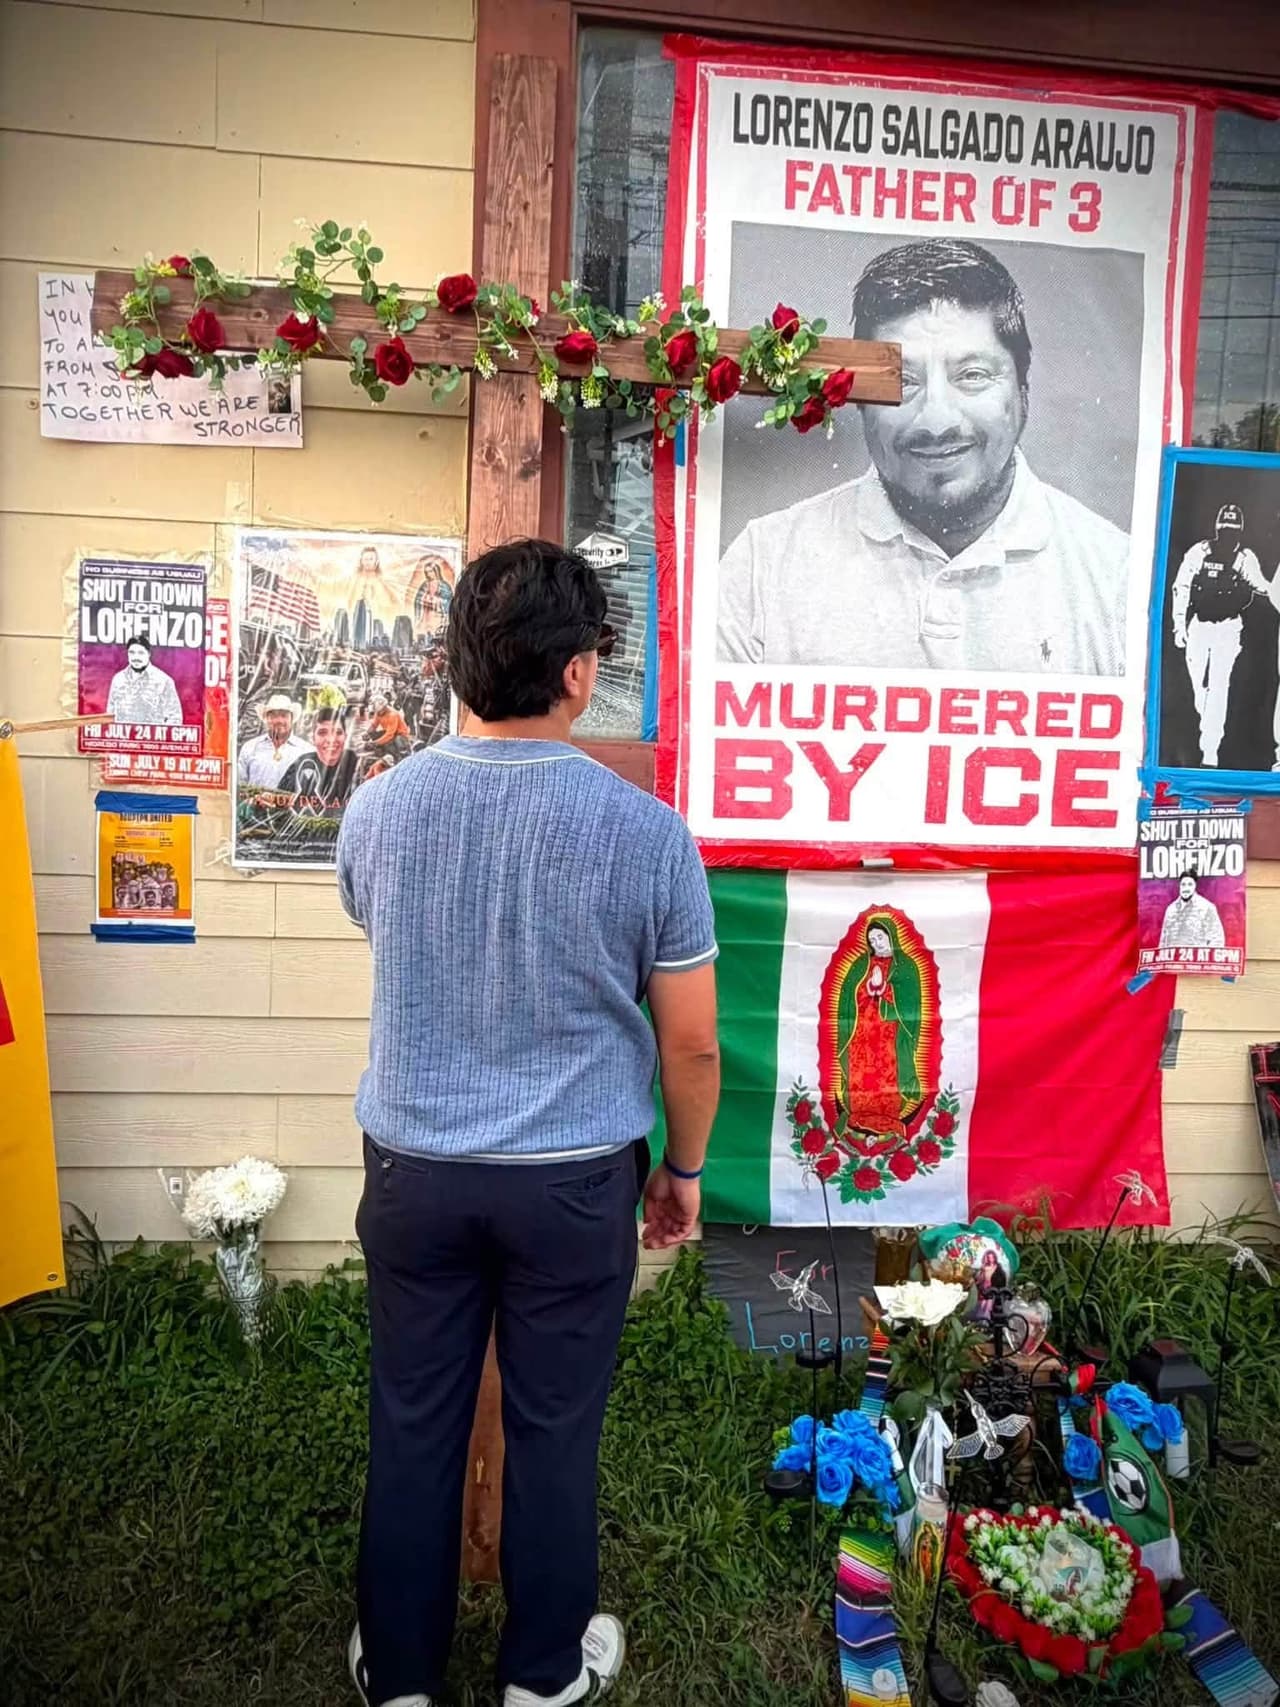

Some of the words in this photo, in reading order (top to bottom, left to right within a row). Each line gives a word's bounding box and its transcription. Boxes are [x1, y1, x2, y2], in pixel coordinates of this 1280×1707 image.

[733, 93, 873, 154] LORENZO
[882, 104, 1024, 163] SALGADO
[1031, 118, 1155, 175] ARAUJO
[785, 160, 976, 223] FATHER
[991, 175, 1057, 228] OF
[1068, 182, 1102, 232] 3
[46, 280, 75, 299] IN
[45, 309, 82, 335] YOU
[44, 338, 65, 353] TO
[44, 360, 95, 378] FROM
[47, 382, 68, 397] AT
[42, 402, 174, 422] TOGETHER
[179, 399, 211, 418] WE
[218, 395, 259, 415] ARE
[193, 411, 300, 437] STRONGER
[82, 578, 127, 602] SHUT
[131, 581, 147, 602] IT
[150, 582, 204, 607] DOWN
[124, 602, 161, 614] FOR
[81, 605, 202, 649] LORENZO
[714, 680, 1124, 739] MURDERED
[105, 724, 132, 740] JULY
[135, 725, 152, 741] 24
[154, 726, 169, 741] AT
[135, 755, 160, 770] JULY
[712, 738, 887, 822] BY
[924, 744, 1121, 828] ICE
[1141, 820, 1178, 841] SHUT
[1181, 820, 1196, 839] IT
[1199, 819, 1244, 840] DOWN
[1176, 840, 1208, 849] FOR
[1141, 844, 1243, 878] LORENZO
